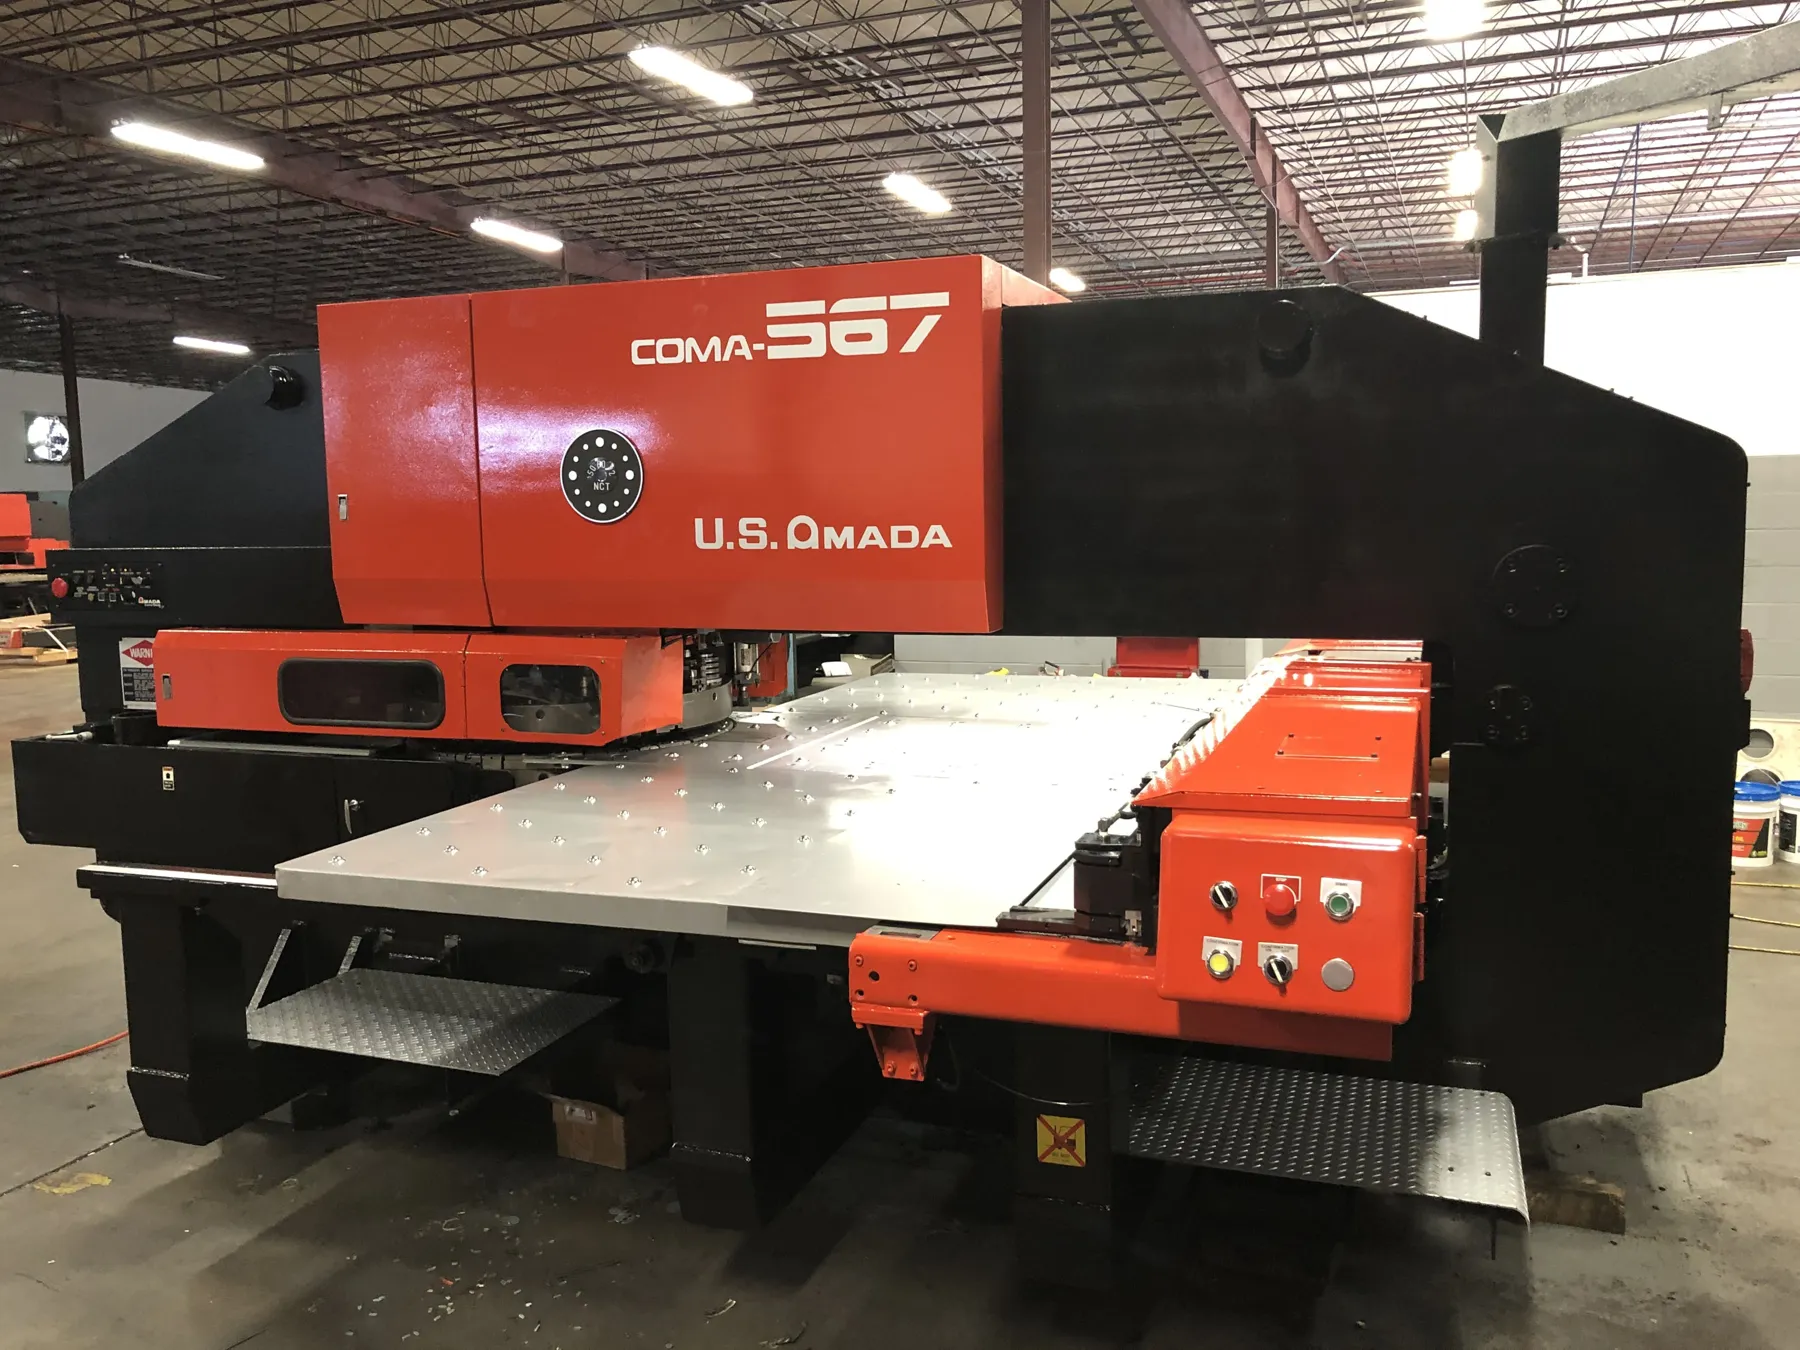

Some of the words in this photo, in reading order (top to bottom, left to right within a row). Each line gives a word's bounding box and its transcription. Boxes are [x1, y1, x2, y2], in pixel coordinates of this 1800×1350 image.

[593, 482, 610, 491] NCT
[694, 517, 778, 550] U.S.
[787, 515, 953, 550] AMADA
[129, 648, 153, 658] WARNI
